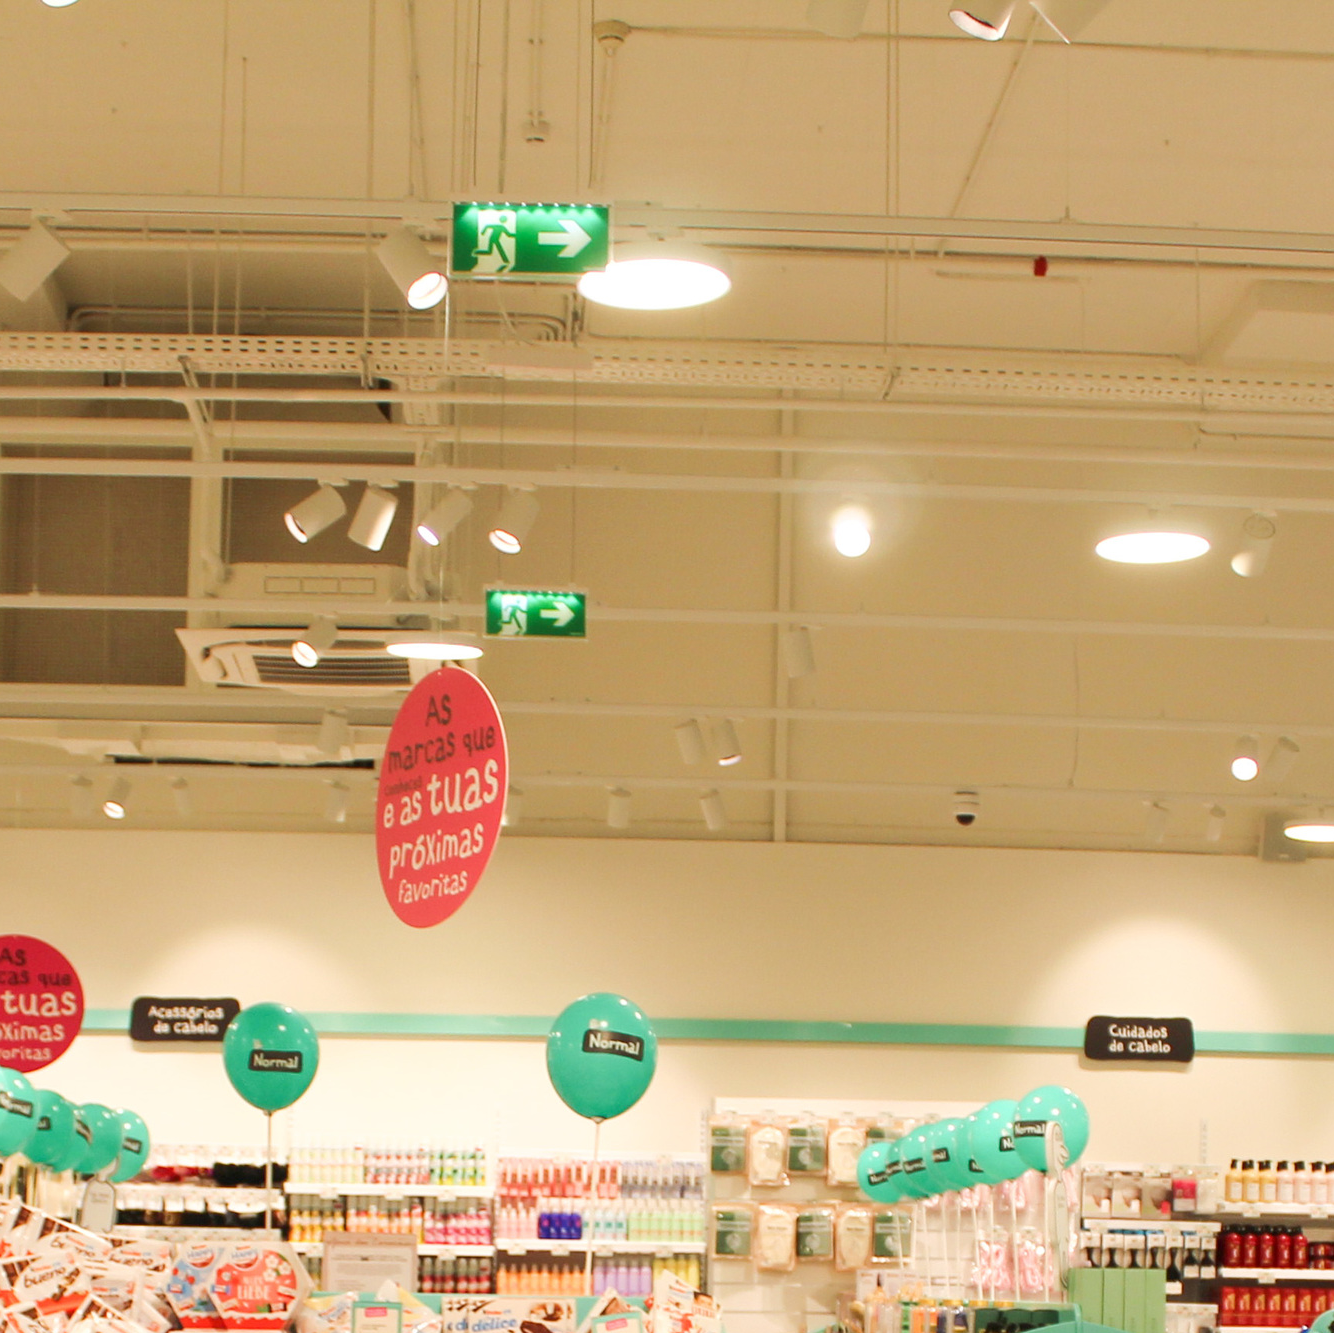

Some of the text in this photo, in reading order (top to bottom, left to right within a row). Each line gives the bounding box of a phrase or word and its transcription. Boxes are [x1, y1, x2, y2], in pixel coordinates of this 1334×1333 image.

[388, 725, 496, 774] marcas que
[383, 759, 499, 828] e as tuas
[389, 822, 484, 879] próximas
[398, 870, 467, 904] favoritas
[1, 988, 77, 1018] tuas
[153, 1019, 218, 1035] de cabelo
[1108, 1024, 1168, 1040] Cuidados
[588, 1033, 640, 1056] Normal
[1108, 1039, 1171, 1055] de cabelo
[253, 1053, 299, 1070] Normal
[23, 1267, 66, 1289] bueno
[472, 1318, 517, 1333] delice
